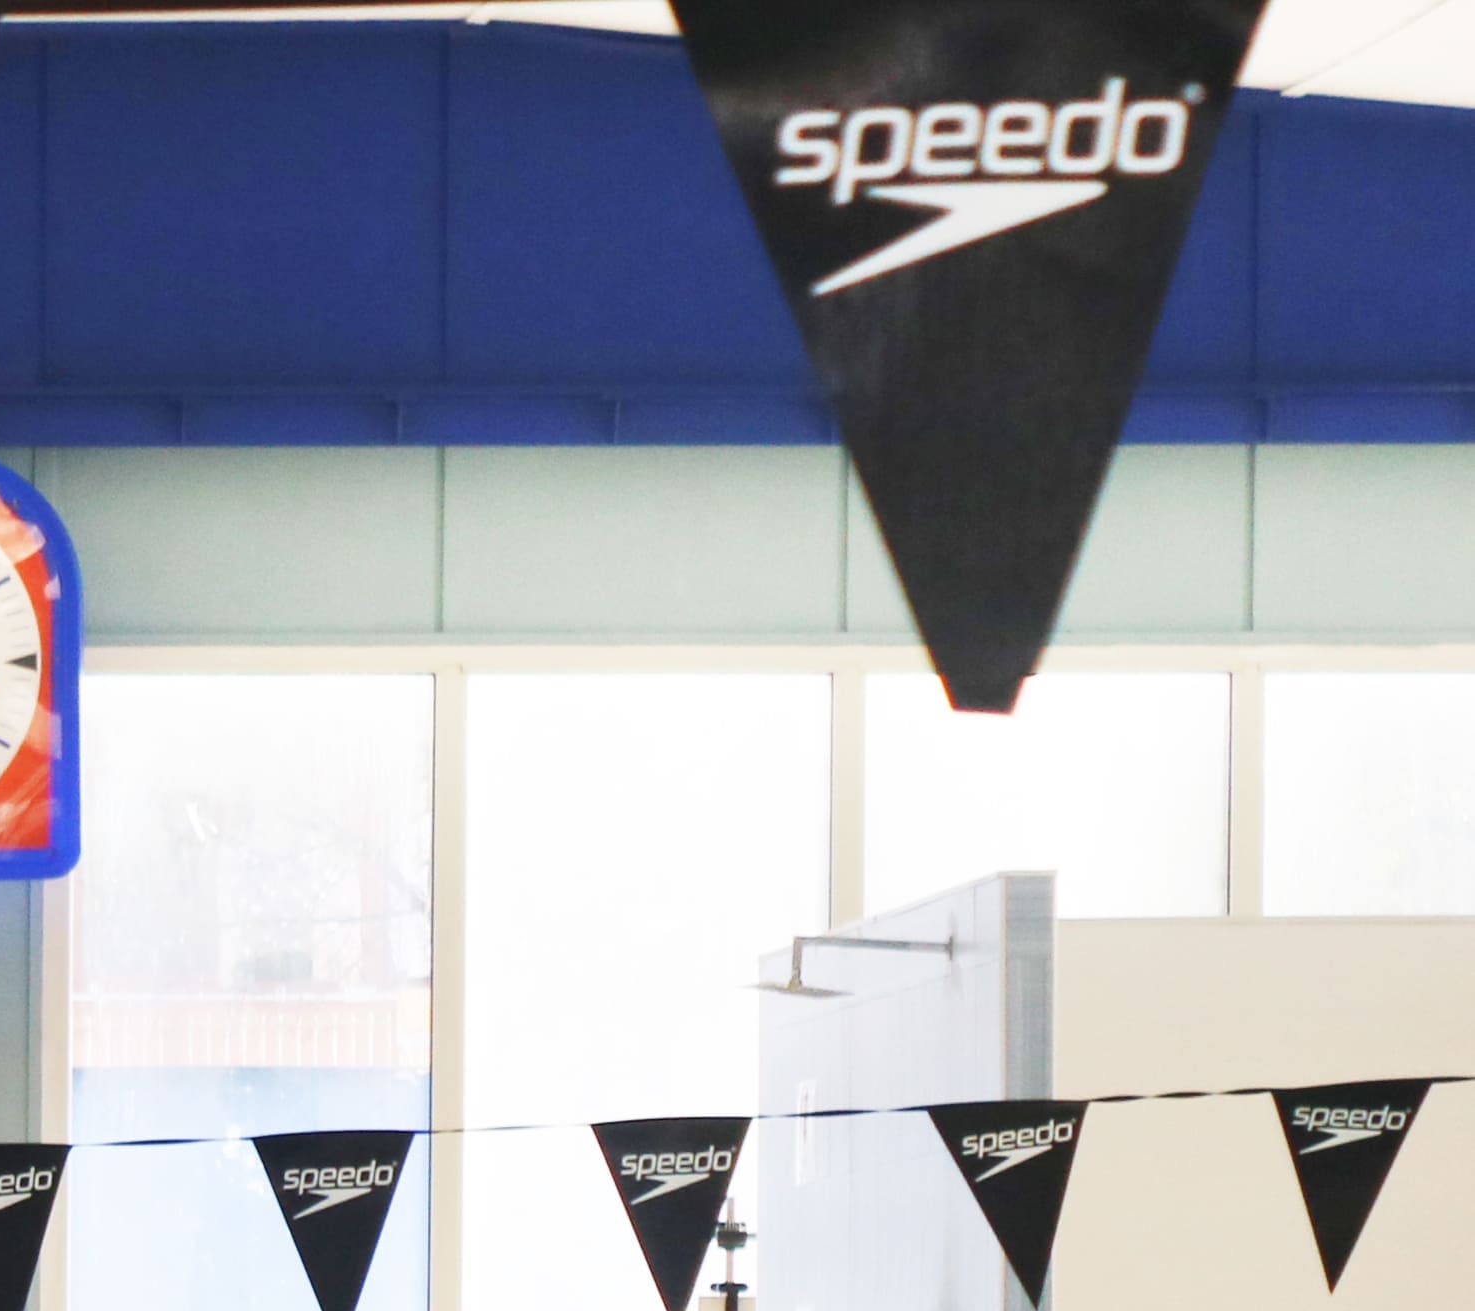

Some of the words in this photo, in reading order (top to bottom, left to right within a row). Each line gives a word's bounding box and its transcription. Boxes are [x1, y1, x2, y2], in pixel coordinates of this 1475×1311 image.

[775, 77, 1186, 204] speedo
[1293, 1107, 1405, 1131] speedo
[962, 1119, 1071, 1156] speedo
[284, 1161, 392, 1193] speedo
[621, 1145, 732, 1178] speedo
